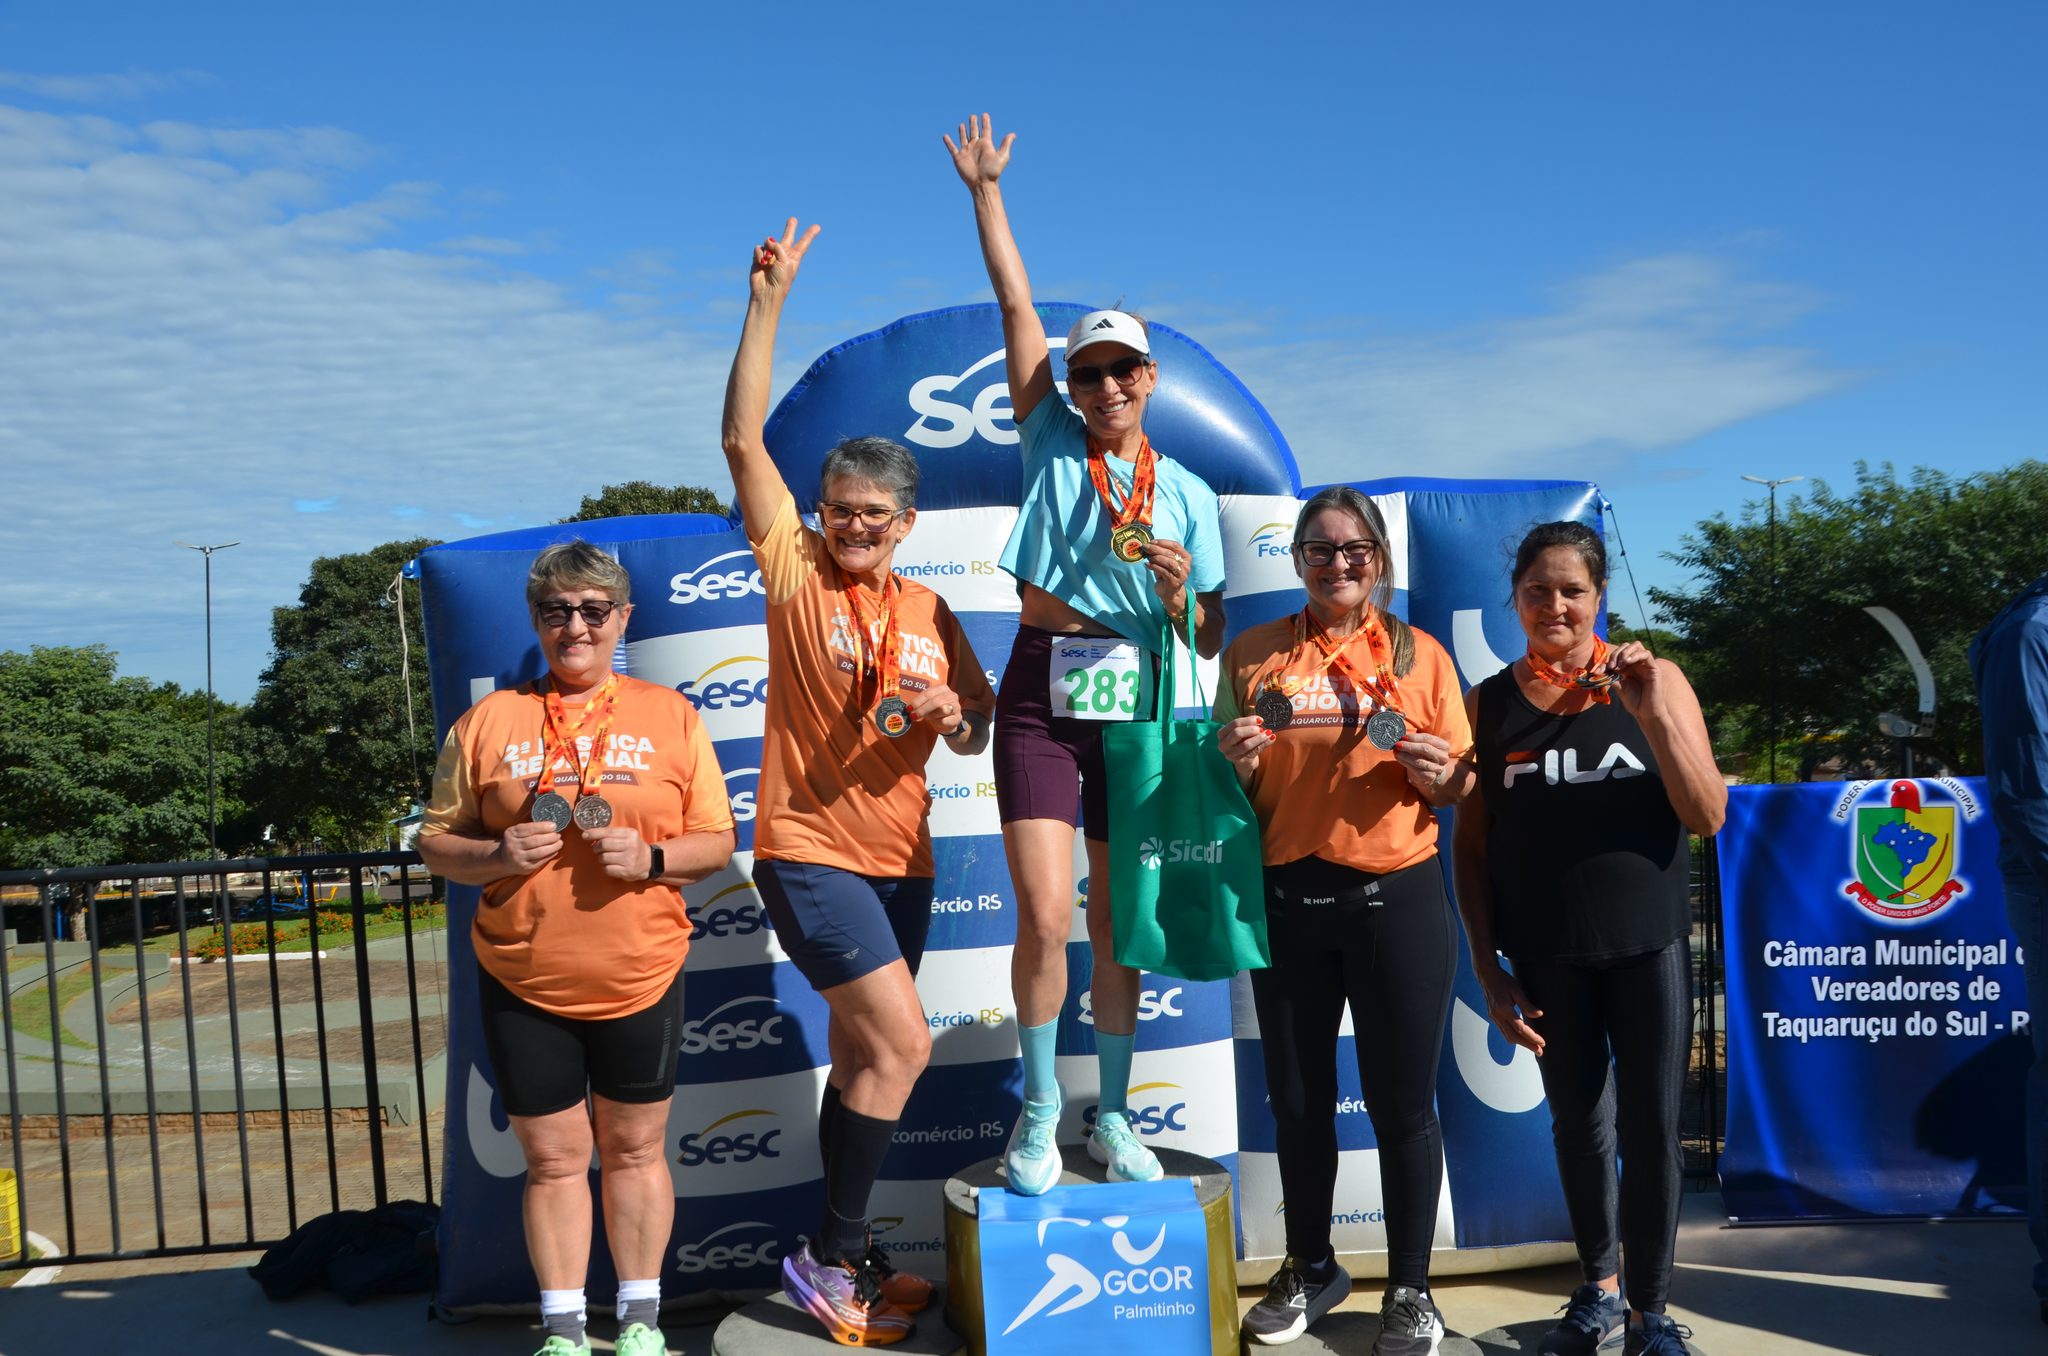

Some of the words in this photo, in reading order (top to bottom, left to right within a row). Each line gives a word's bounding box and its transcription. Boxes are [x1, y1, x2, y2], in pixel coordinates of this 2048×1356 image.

[904, 375, 1070, 449] Se
[891, 561, 965, 577] omércio
[971, 560, 995, 575] RS
[901, 678, 913, 687] DO
[914, 681, 927, 690] SUL
[985, 669, 998, 686] S
[1064, 668, 1140, 714] 283
[1290, 716, 1339, 726] AQUARUÇU
[538, 734, 656, 754] SICA
[511, 750, 651, 780] REOAL
[1503, 742, 1647, 789] FILA
[615, 773, 632, 782] SUL
[928, 783, 971, 799] ércio
[976, 782, 997, 798] RS
[1836, 784, 1862, 819] PODER
[931, 896, 973, 914] ércio
[978, 894, 1002, 911] RS
[1313, 896, 1335, 905] HUPI
[1763, 940, 1867, 967] Câmara
[1875, 939, 2007, 972] Municipal
[1811, 976, 1960, 1002] Vereadores
[1967, 975, 2001, 1001] de
[925, 1011, 974, 1029] ércio
[980, 1008, 1004, 1026] RS
[1762, 1012, 1897, 1043] Taquaruçu
[1905, 1011, 1938, 1037] do
[1946, 1010, 1988, 1037] Sul
[2011, 1011, 2030, 1036] R
[680, 1016, 782, 1054] Sesc
[891, 1125, 974, 1143] comércio
[980, 1121, 1004, 1138] RS
[677, 1129, 781, 1167] Sesc
[1331, 1208, 1386, 1225] mérci
[677, 1240, 778, 1273] Sesc
[1103, 1265, 1194, 1296] GCOR
[1114, 1302, 1195, 1320] Palmitinho
